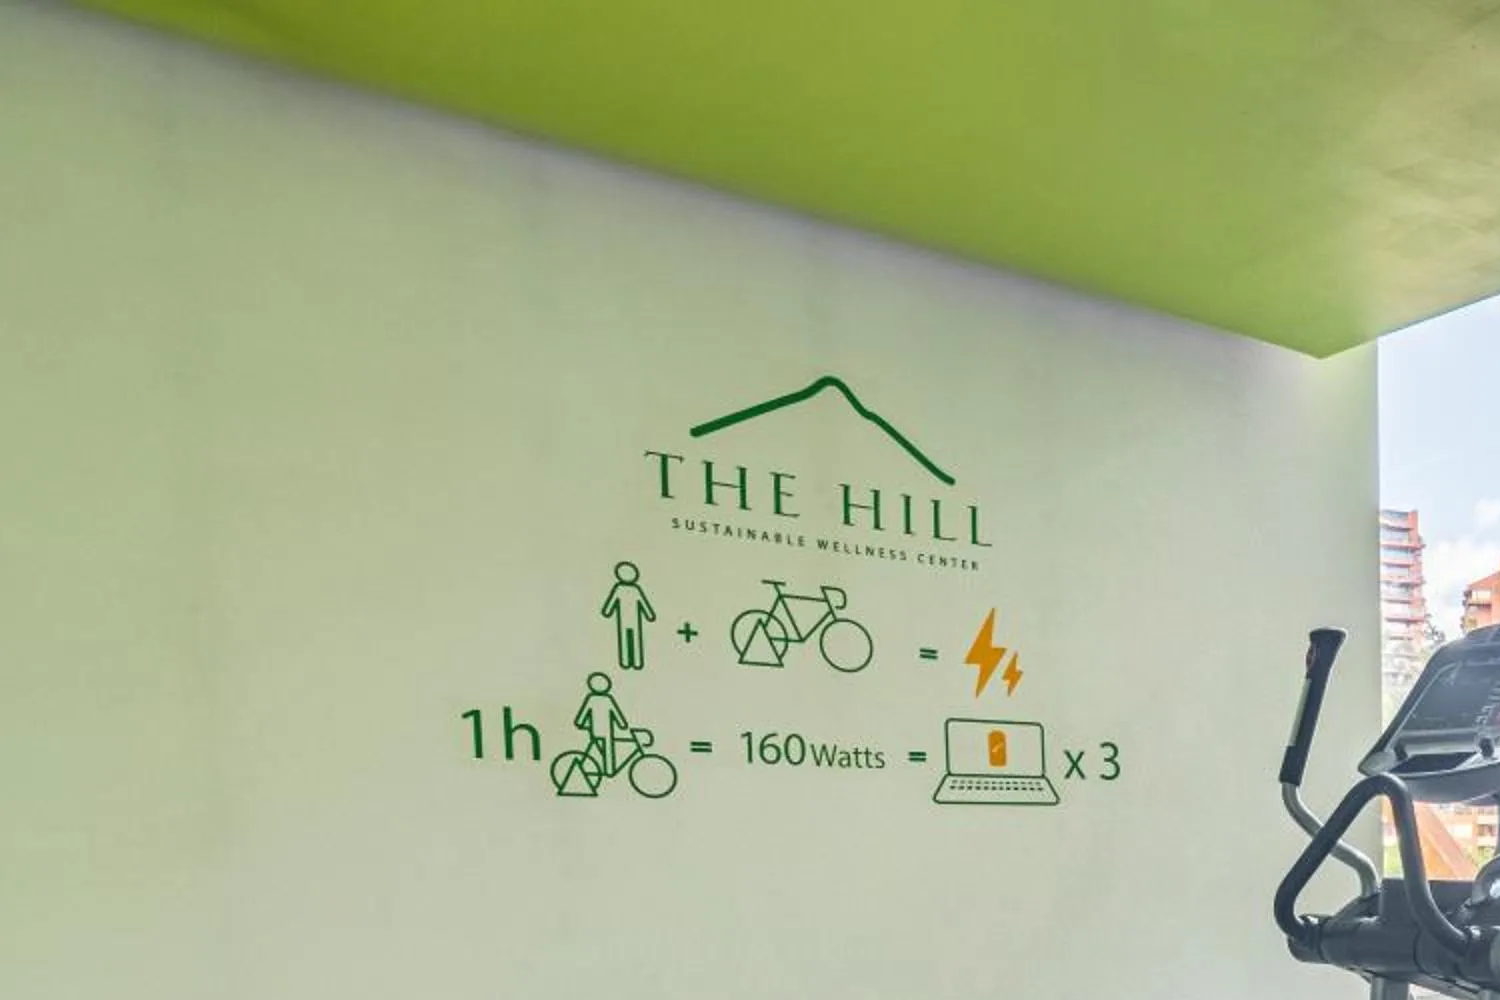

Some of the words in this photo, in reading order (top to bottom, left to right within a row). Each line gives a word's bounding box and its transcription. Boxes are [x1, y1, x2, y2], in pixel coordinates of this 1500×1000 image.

[643, 450, 801, 518] THE
[838, 484, 993, 547] HILL
[672, 517, 806, 548] SUSTAINABLE
[816, 538, 907, 562] WELLNESS
[916, 553, 979, 571] CENTER
[461, 706, 541, 761] 1h
